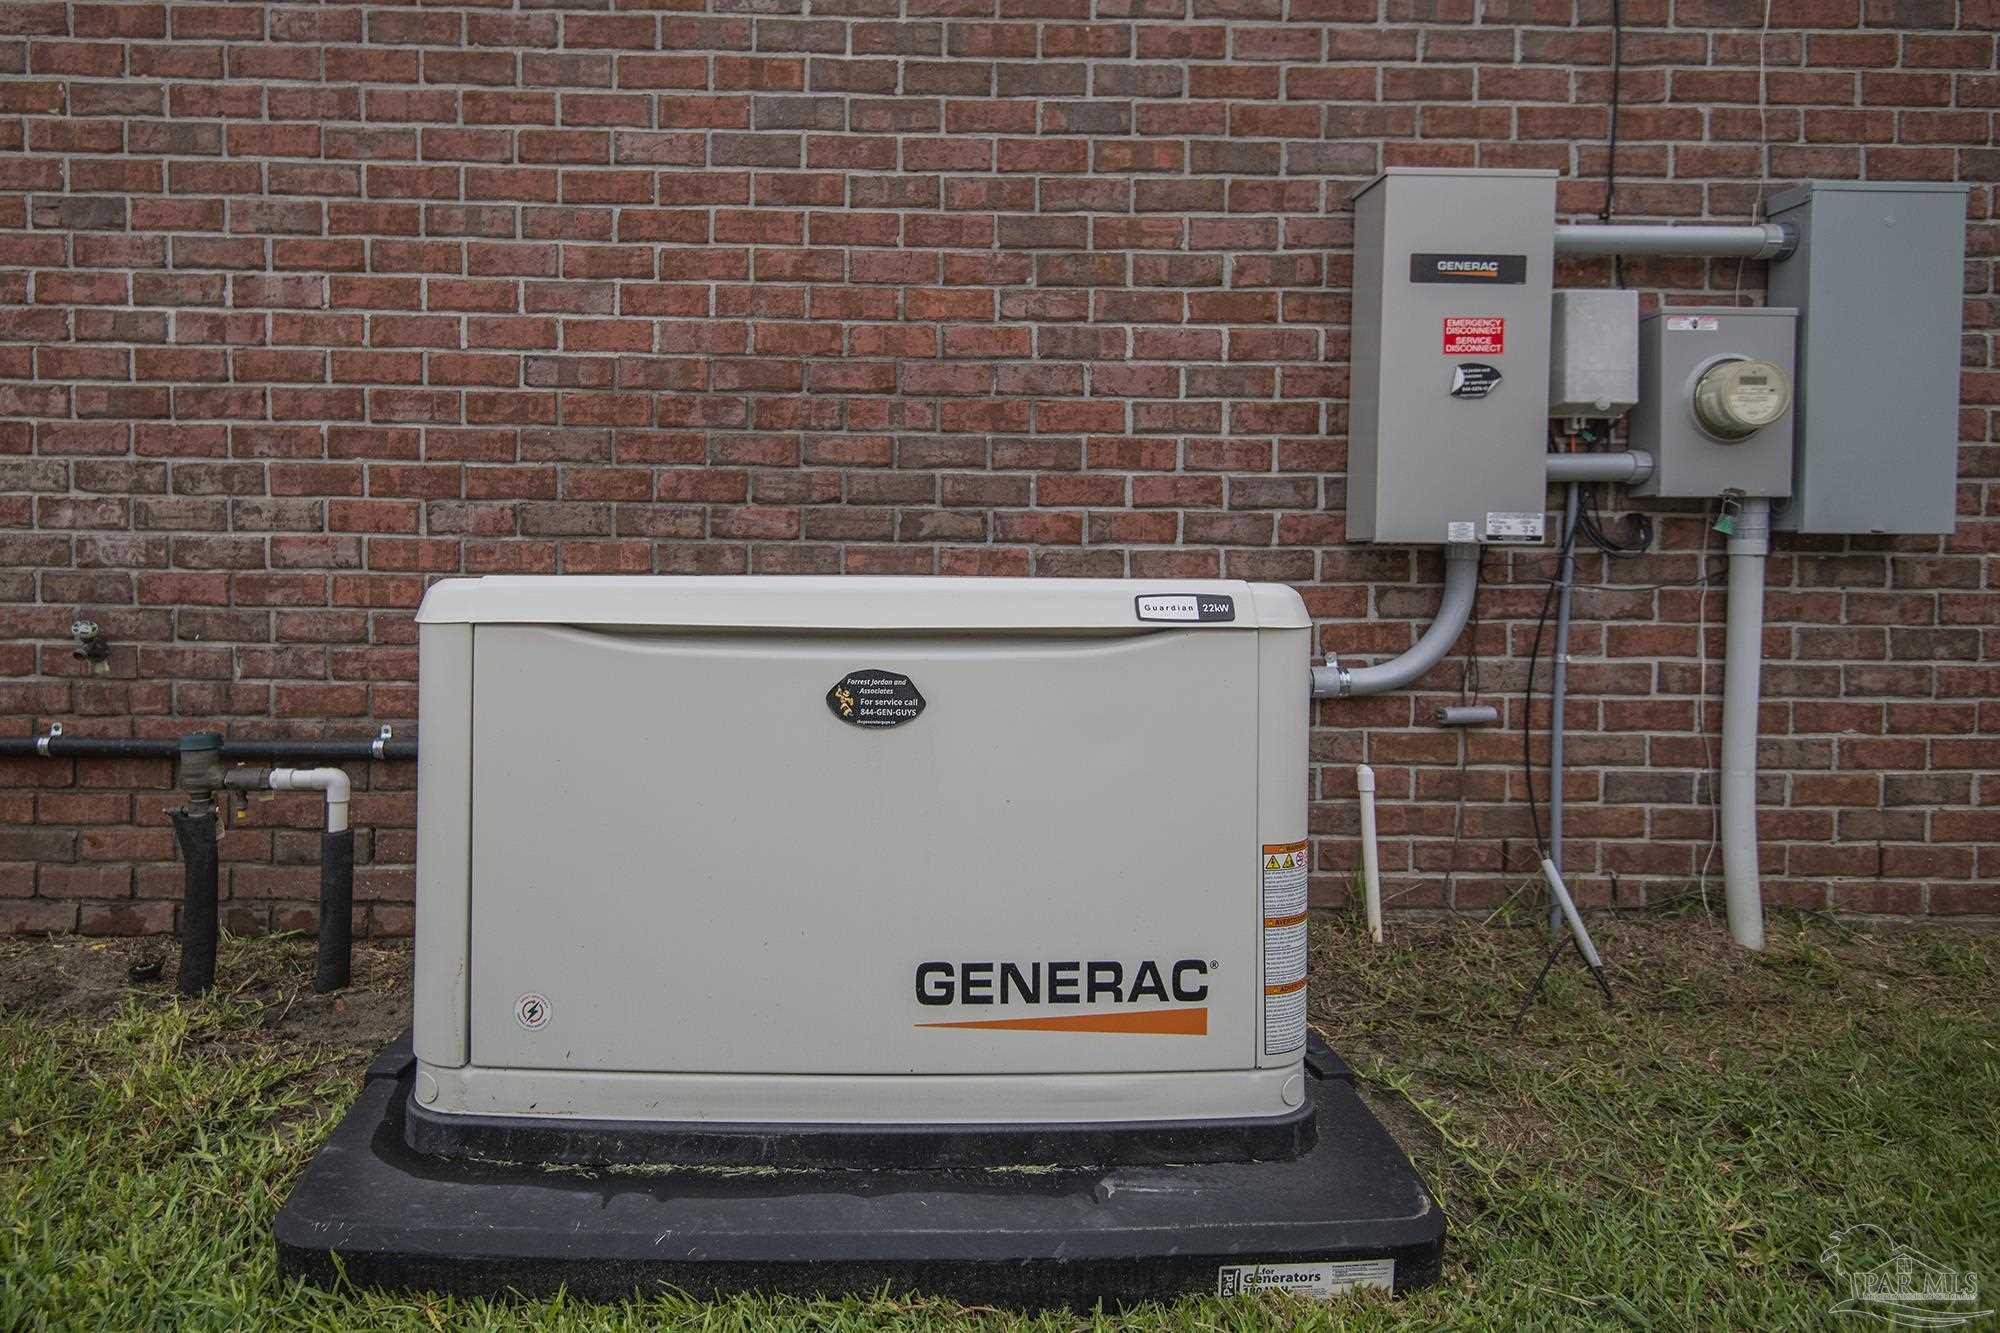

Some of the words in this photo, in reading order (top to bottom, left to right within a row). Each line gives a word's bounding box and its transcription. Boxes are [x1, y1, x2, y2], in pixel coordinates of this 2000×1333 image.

[1437, 261, 1498, 271] GENERAC
[1446, 319, 1501, 327] EMERGENCY
[1445, 326, 1502, 335] DISCONNECT
[1455, 336, 1492, 345] SERVICE
[1445, 344, 1502, 353] DISCONNECT
[1144, 604, 1194, 612] Guardian
[1202, 603, 1229, 613] 22kW
[870, 679, 893, 687] Jordan
[860, 698, 874, 706] For
[874, 698, 903, 706] service
[904, 698, 918, 706] call
[860, 708, 917, 717] 844-GEN-GUYS
[1243, 1271, 1322, 1285] Generators
